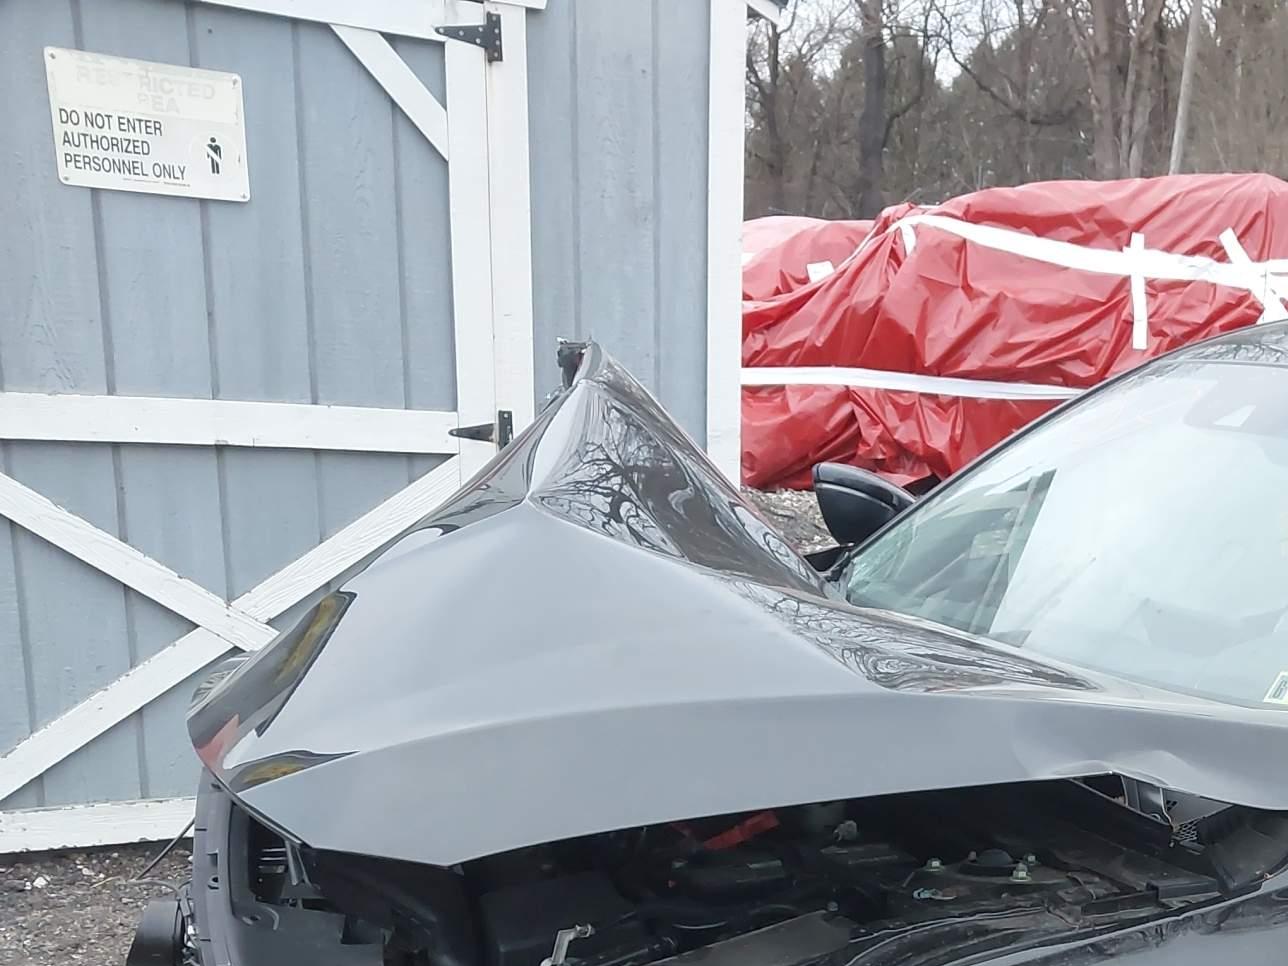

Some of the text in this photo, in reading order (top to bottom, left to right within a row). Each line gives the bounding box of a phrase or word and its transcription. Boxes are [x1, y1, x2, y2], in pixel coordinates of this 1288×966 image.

[59, 108, 163, 136] DO NOT ENTER
[62, 130, 150, 156] AUTHORIZED
[64, 153, 186, 181] PERSONNEL ONLY
